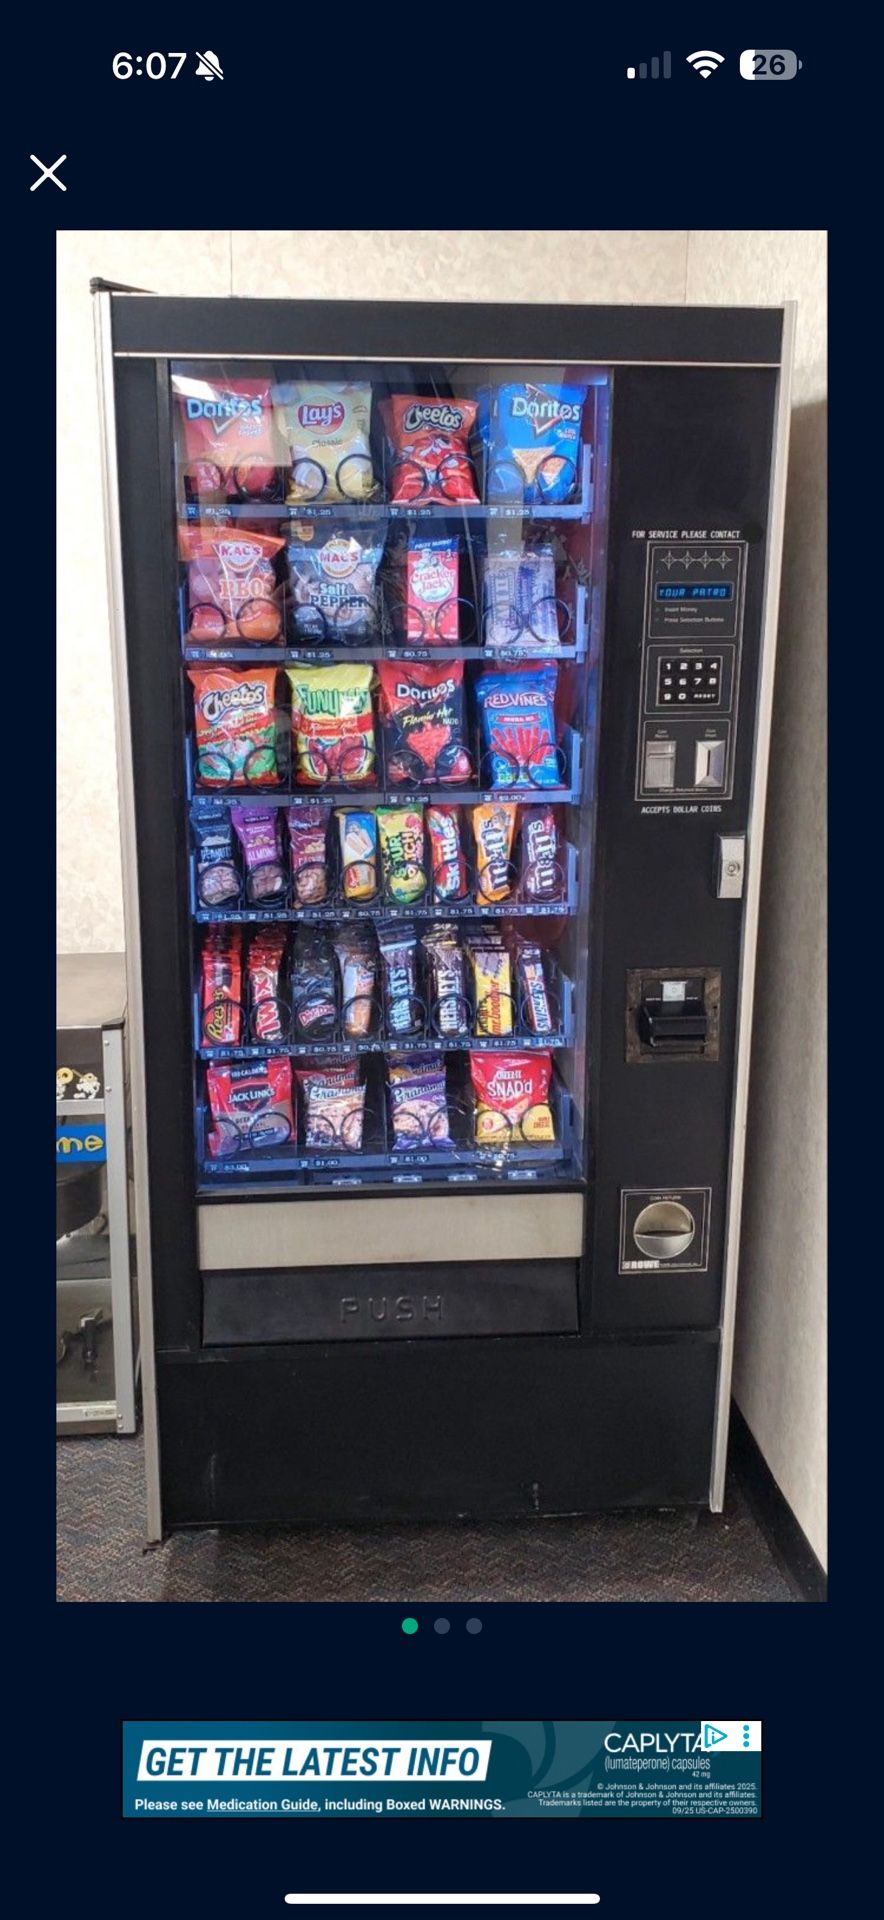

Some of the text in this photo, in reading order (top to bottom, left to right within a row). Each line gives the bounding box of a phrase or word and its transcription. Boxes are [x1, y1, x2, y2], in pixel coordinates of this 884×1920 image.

[185, 397, 263, 421] Doritos
[302, 401, 343, 427] Lay's
[403, 403, 464, 432] Cheetos
[511, 396, 581, 421] Doritos
[631, 530, 741, 539] FOR SERVICE PLEASE CONTACT
[319, 582, 347, 596] Salt
[659, 588, 727, 597] YOUR PATRO
[310, 594, 369, 609] PEPPER
[396, 678, 455, 700] Doritos
[201, 683, 265, 723] Cheetos
[484, 691, 511, 709] RED
[509, 691, 548, 707] VINES
[641, 805, 722, 814] ACCEPTS DOLLAR COINS
[254, 974, 281, 1039] TWIX
[228, 1091, 249, 1103] JACK
[631, 1260, 660, 1269] ROWE
[340, 1294, 446, 1323] PUSH
